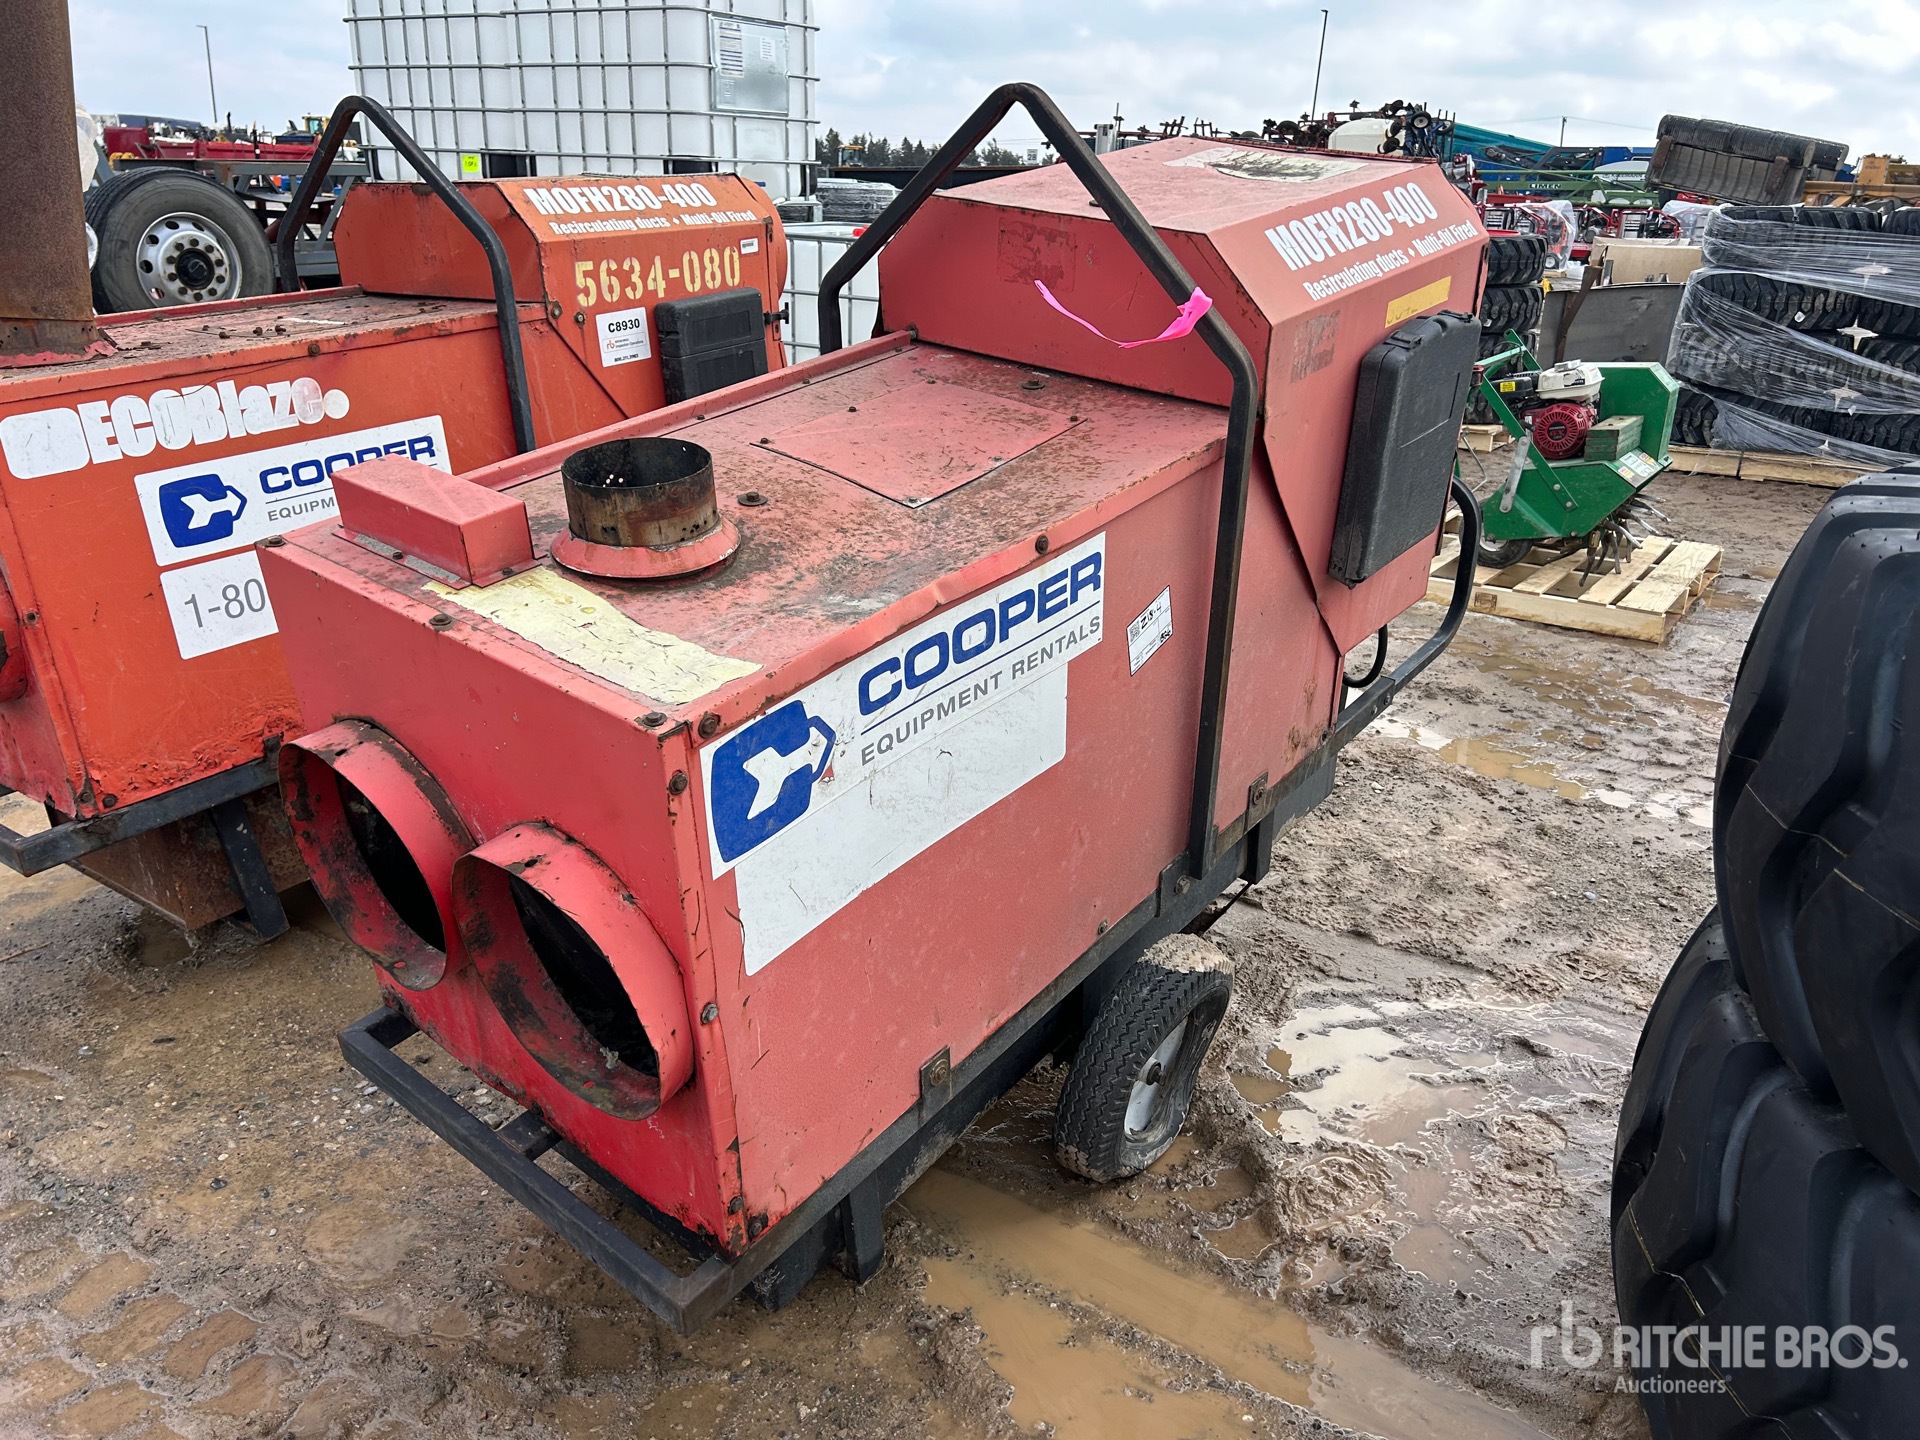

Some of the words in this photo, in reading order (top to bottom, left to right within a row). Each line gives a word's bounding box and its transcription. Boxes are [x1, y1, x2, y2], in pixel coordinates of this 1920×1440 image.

[523, 182, 717, 215] MOFH280-400
[549, 218, 638, 236] Recirculating
[634, 217, 671, 231] ducts
[680, 213, 729, 227] Multi-Oil
[728, 210, 758, 223] Fired
[1264, 182, 1438, 272] MOFH280-400
[575, 246, 741, 307] 5634-080
[1303, 254, 1382, 302] Recirculating
[1376, 248, 1410, 277] ducts
[1412, 228, 1455, 258] Multi-Oil
[1450, 219, 1479, 245] Fired
[608, 318, 640, 333] C8930
[858, 551, 1101, 716] COOPER
[861, 671, 1003, 766] EQUIPMENT
[1011, 615, 1101, 680] RENTALS
